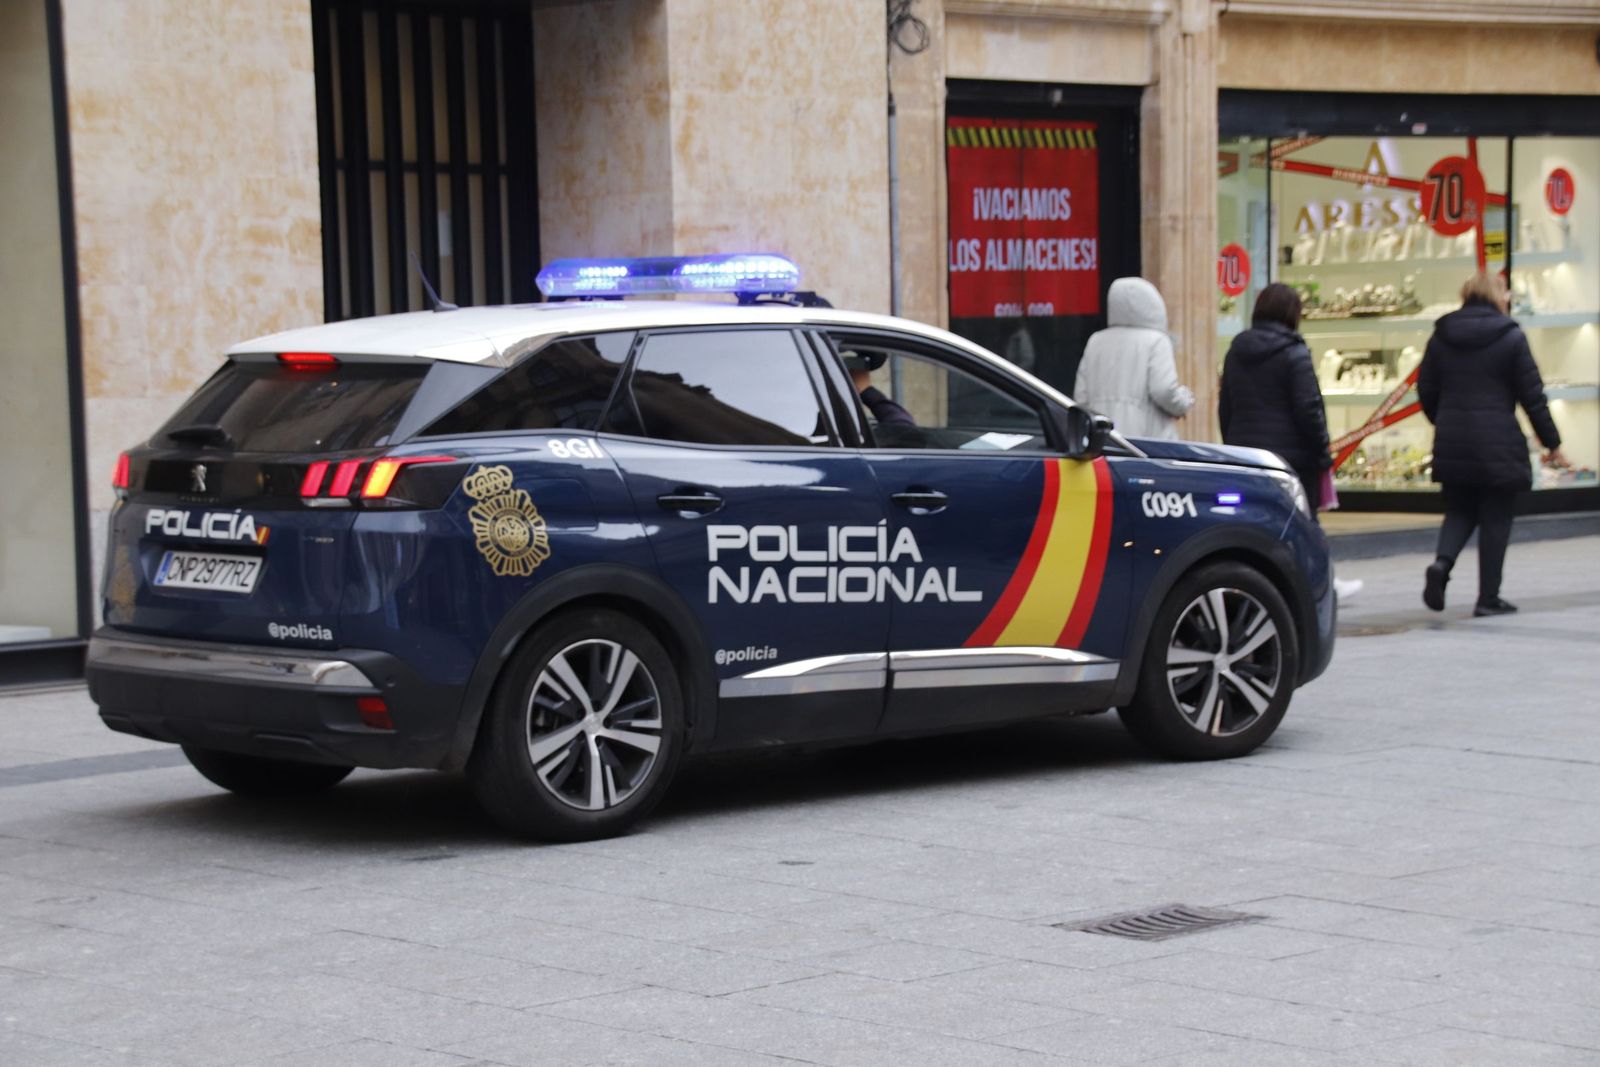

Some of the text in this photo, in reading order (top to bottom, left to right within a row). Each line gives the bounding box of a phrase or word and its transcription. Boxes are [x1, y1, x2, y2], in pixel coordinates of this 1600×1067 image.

[949, 238, 1097, 272] LOS ALMACENES!
[146, 508, 258, 542] POLICÍA
[706, 518, 923, 562] POLICÍA
[708, 566, 983, 603] NACIONAL
[268, 621, 333, 641] @policia
[714, 646, 778, 665] @policia
